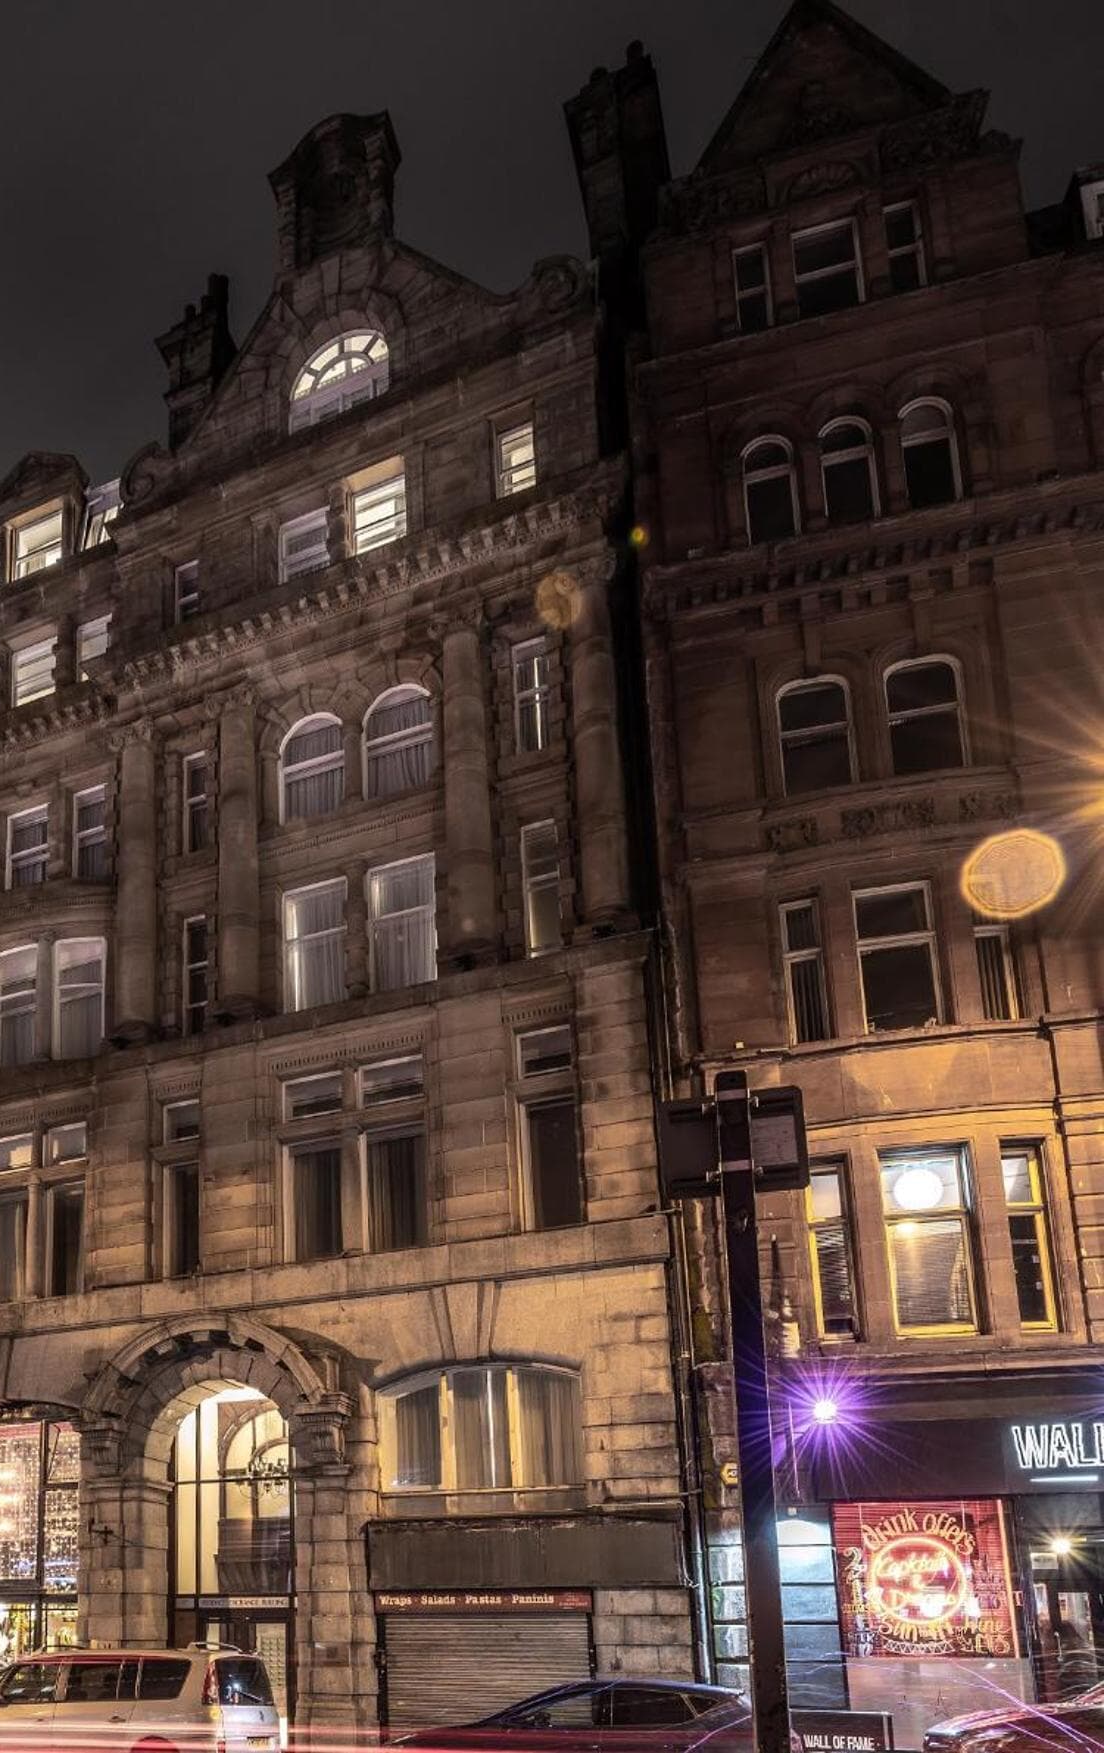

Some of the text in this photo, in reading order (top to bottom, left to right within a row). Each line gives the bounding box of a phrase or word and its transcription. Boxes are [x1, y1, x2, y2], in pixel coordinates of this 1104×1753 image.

[861, 1508, 976, 1555] drink offers
[379, 1595, 412, 1606] Wraps
[420, 1595, 455, 1605] Salads
[465, 1594, 502, 1605] Pastas
[512, 1593, 554, 1604] Paninis
[803, 1734, 875, 1751] WALL OF FAME
